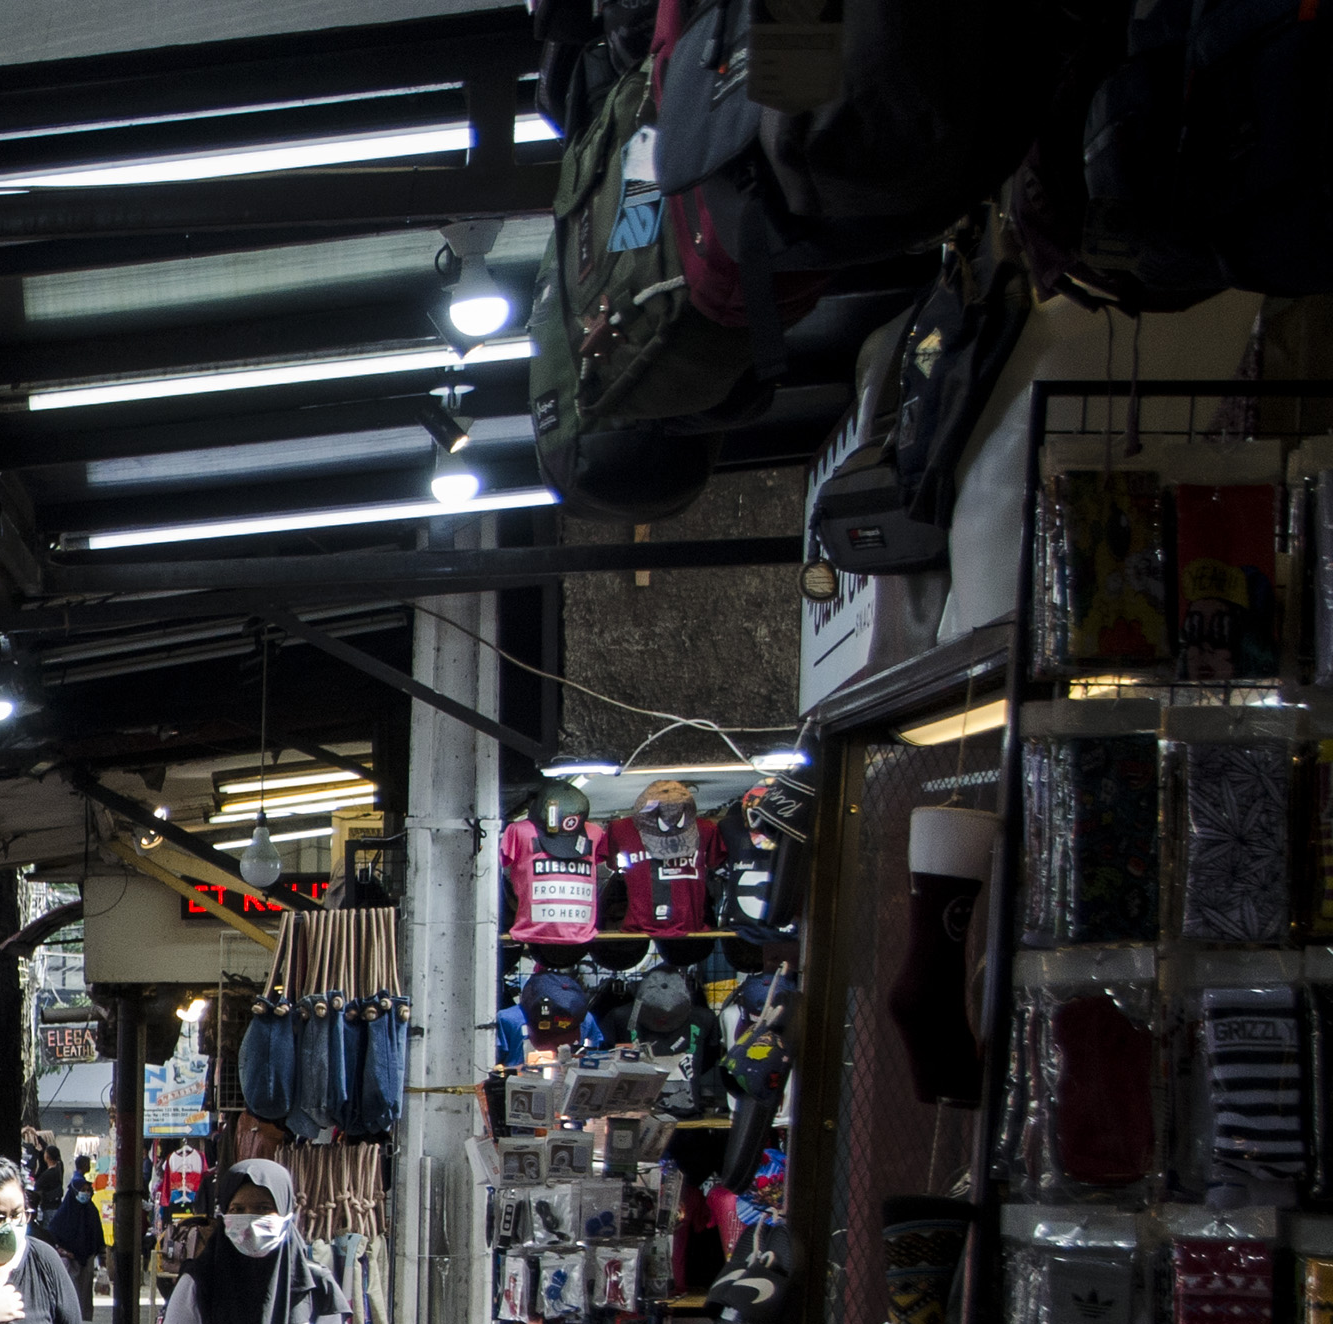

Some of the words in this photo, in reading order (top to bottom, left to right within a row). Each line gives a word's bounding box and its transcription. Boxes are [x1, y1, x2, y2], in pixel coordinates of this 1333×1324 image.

[534, 885, 566, 895] FROM
[569, 886, 592, 897] ZERO
[541, 908, 555, 917] TO
[560, 909, 587, 919] HERO
[47, 1029, 99, 1047] ELEGA
